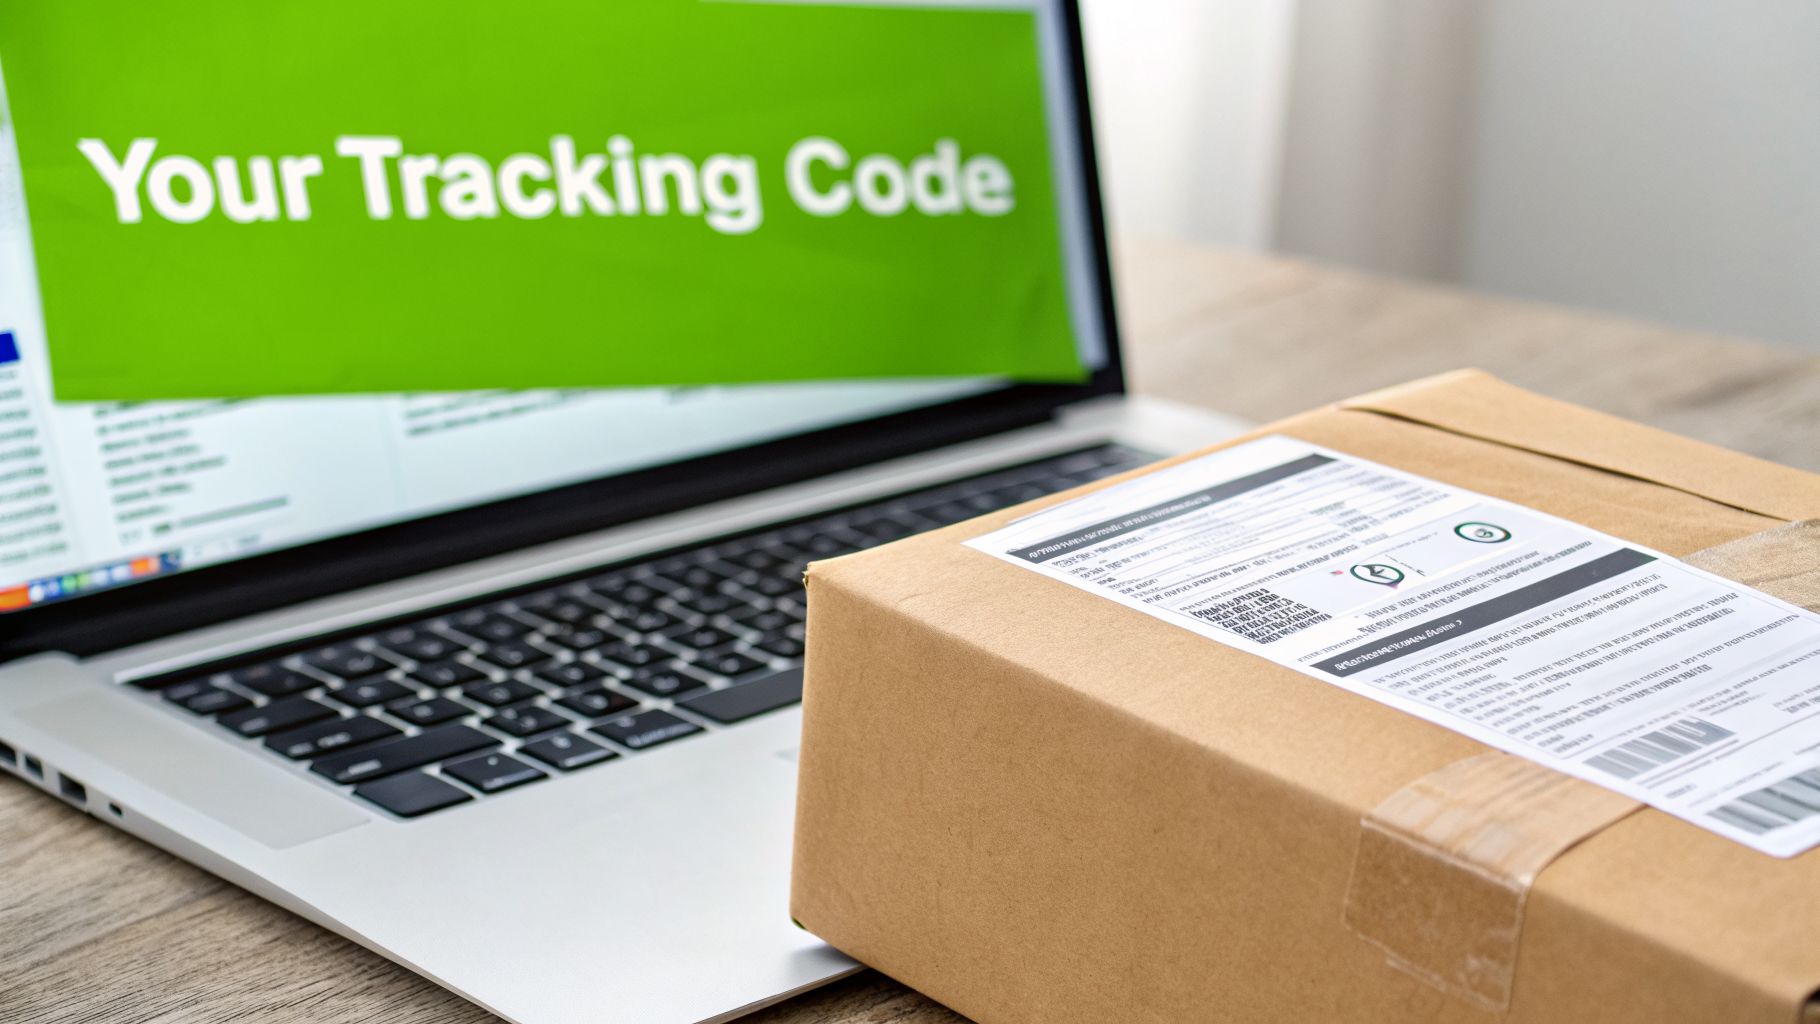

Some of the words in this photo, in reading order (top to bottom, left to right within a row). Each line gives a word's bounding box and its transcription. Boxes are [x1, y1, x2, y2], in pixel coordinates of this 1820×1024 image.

[77, 137, 323, 223] Your
[336, 135, 762, 234] Tracking
[786, 137, 1014, 217] Code
